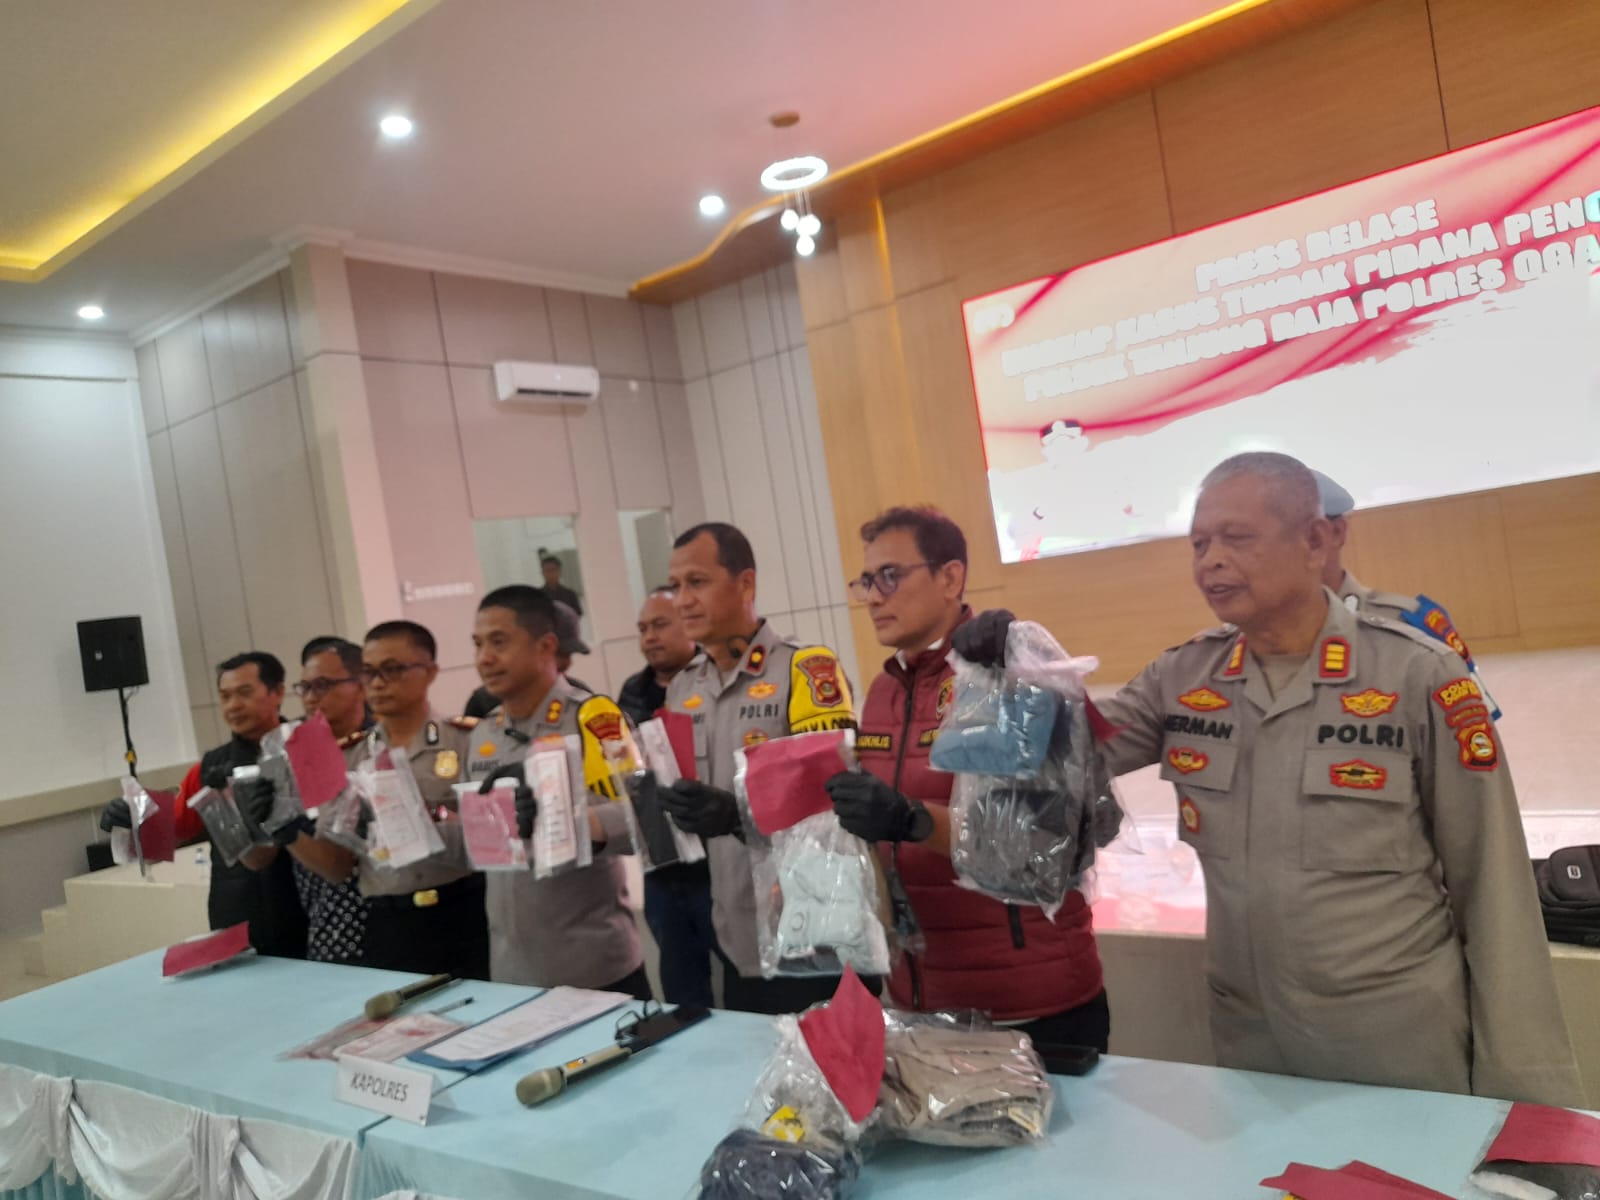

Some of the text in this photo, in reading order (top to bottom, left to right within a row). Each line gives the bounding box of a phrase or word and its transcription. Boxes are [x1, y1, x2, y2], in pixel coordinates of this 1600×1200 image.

[1354, 222, 1499, 285] PIDANA
[1362, 259, 1506, 319] POLRES
[739, 704, 779, 719] POLRI
[1317, 723, 1404, 748] POLRI
[350, 1072, 409, 1102] KAPOLRES
